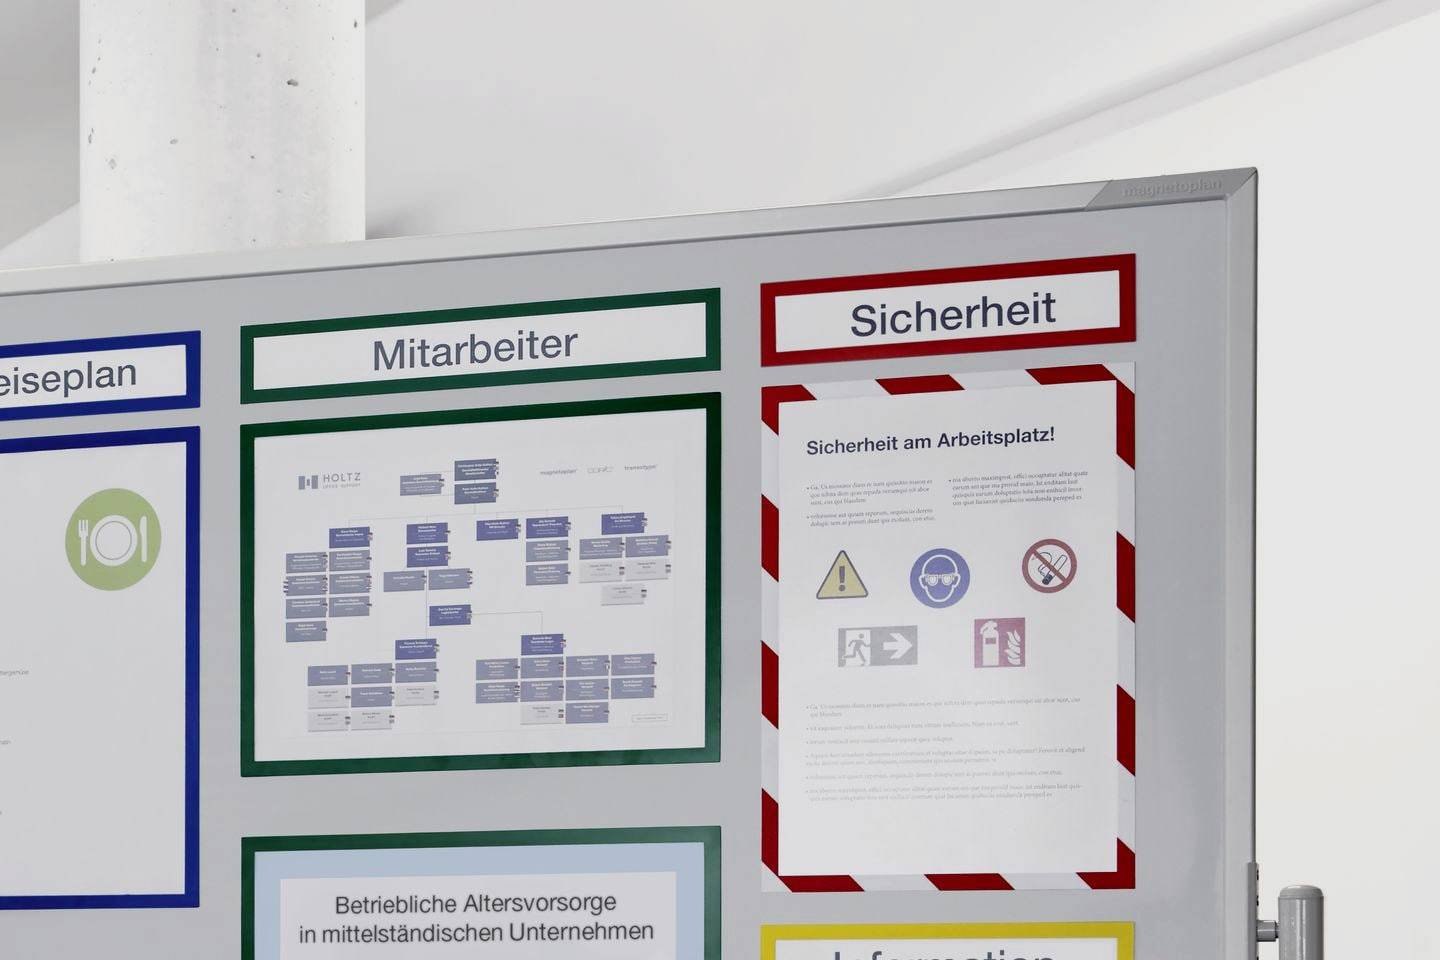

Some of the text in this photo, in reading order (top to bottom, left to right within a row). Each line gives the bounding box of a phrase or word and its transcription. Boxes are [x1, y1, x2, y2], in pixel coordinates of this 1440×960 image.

[1122, 178, 1222, 197] magnetoplan
[850, 291, 1056, 337] Sicherheit
[374, 329, 578, 371] Mitarbeiter
[806, 426, 1054, 455] Sicherheit am Arbeitsplatz!
[322, 471, 360, 485] HOLTZ
[335, 894, 616, 915] Betriebliche Altersvorsorge
[299, 921, 653, 943] in mittelständischen Unternehmen
